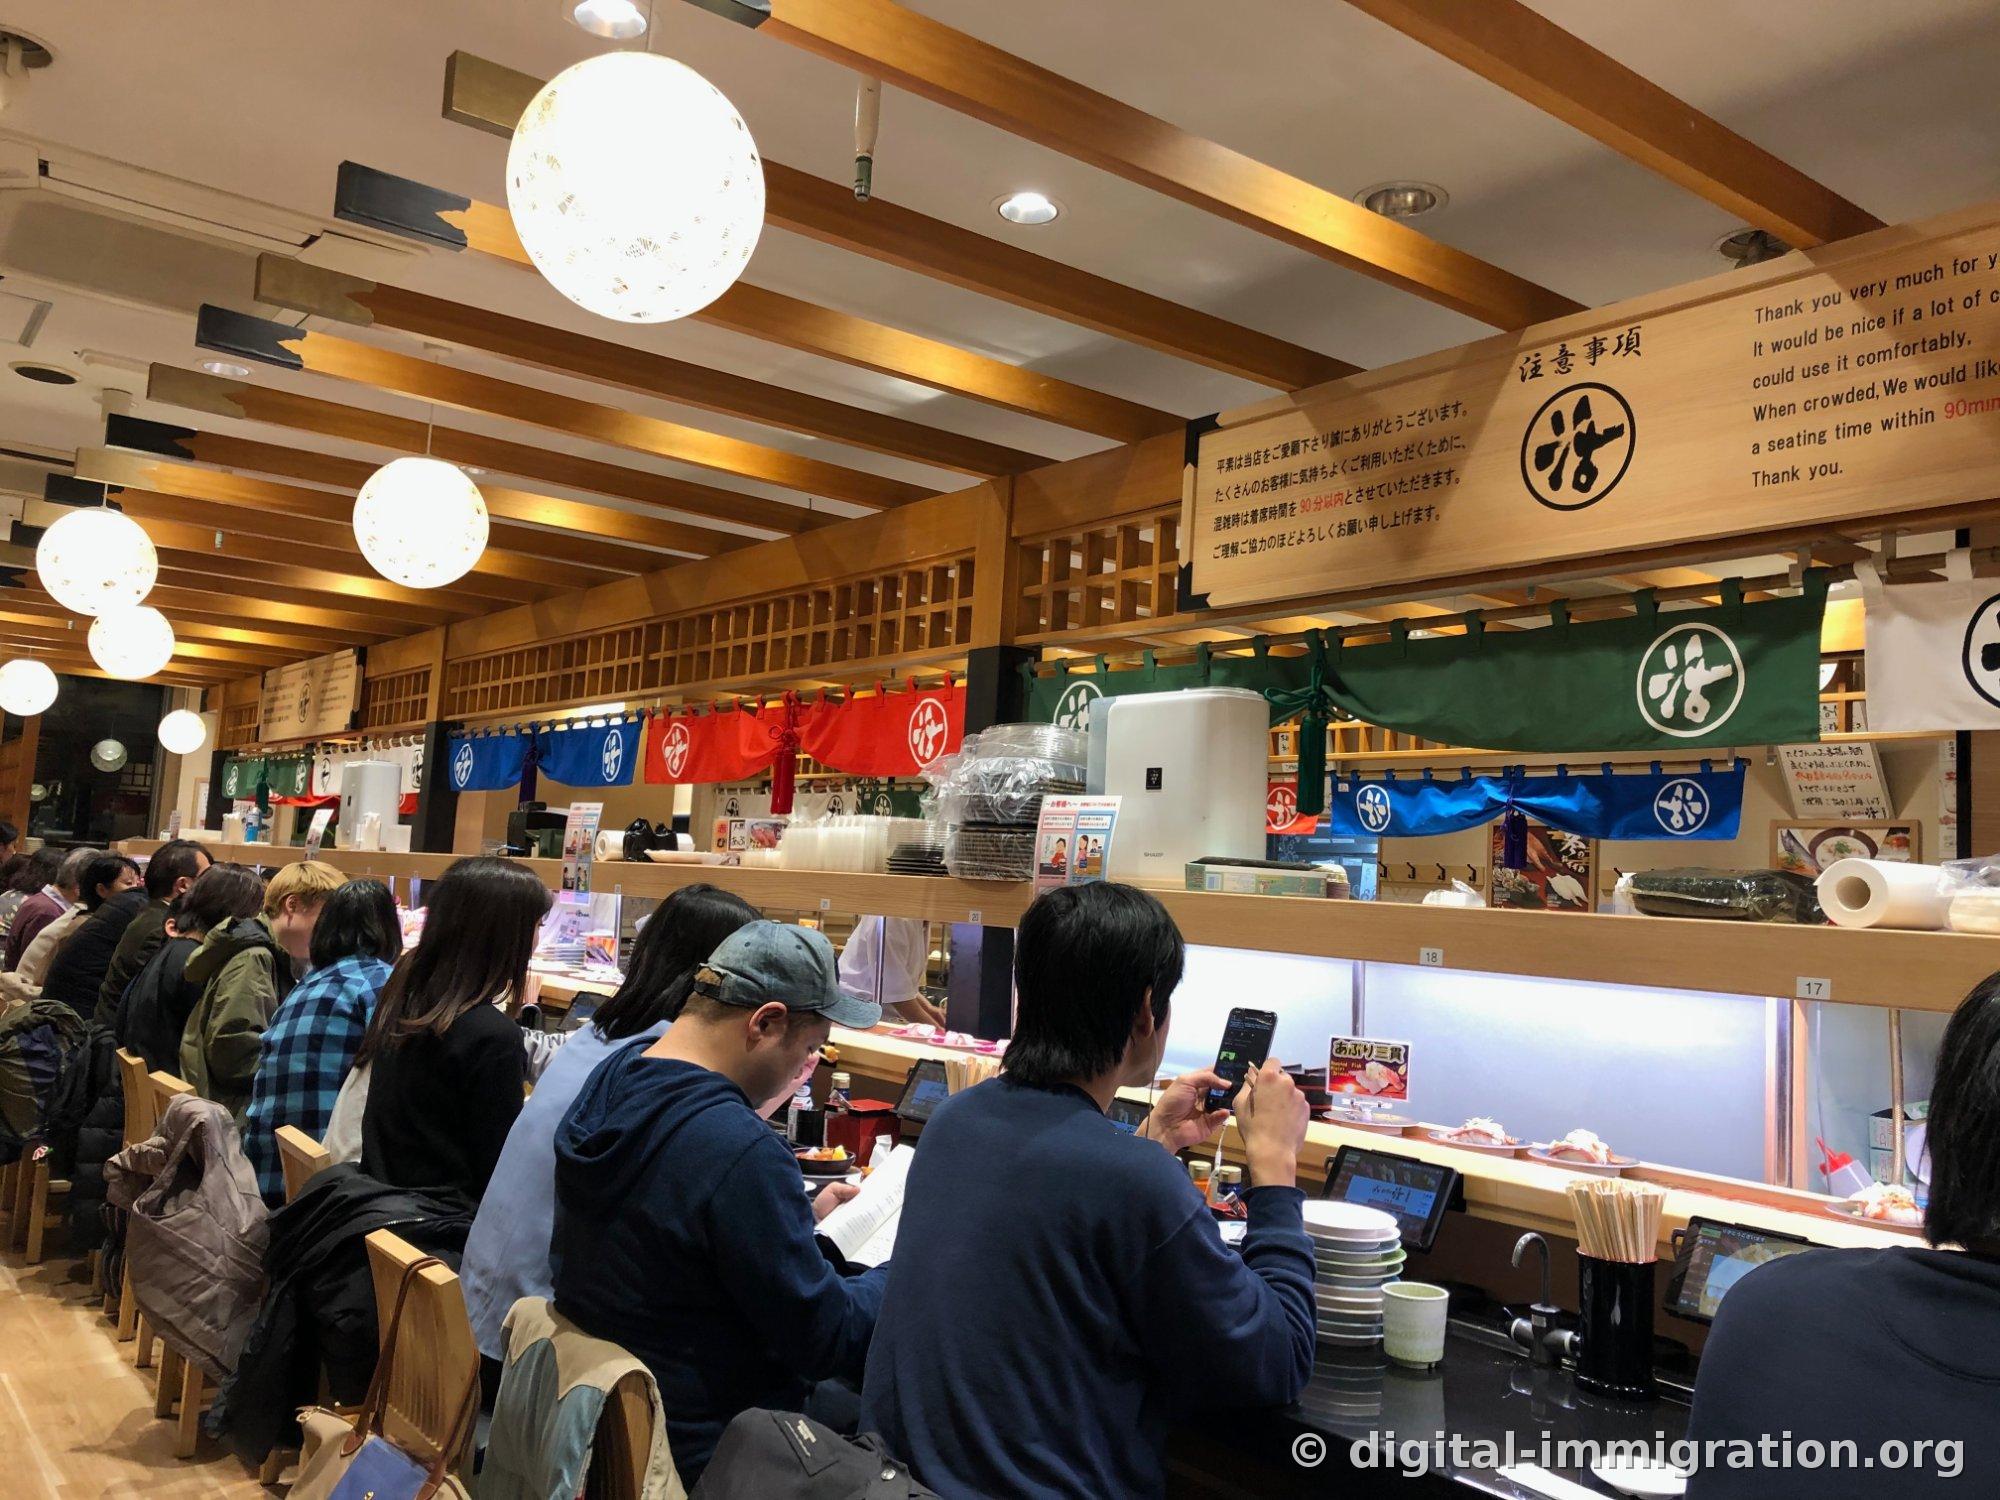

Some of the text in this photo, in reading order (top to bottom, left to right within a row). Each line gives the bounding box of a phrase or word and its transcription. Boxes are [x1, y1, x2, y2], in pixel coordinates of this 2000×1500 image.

[1755, 300, 1803, 324] Thank
[1812, 292, 1841, 312] you
[1850, 280, 1887, 301] very
[1896, 265, 1943, 290] much
[1953, 257, 1978, 276] for
[1754, 342, 1763, 357] It
[1771, 330, 1817, 353] would
[1825, 325, 1844, 341] be
[1852, 316, 1885, 335] nice
[1893, 309, 1904, 325] if
[1913, 310, 1923, 321] a
[1932, 299, 1954, 316] lot
[1963, 291, 1980, 309] of
[1518, 326, 1643, 383] 注意事項
[1753, 368, 1794, 389] could
[1802, 362, 1830, 379] use
[1838, 356, 1848, 371] it
[1753, 402, 1796, 422] When
[1914, 366, 1966, 390] would
[1752, 442, 1760, 455] a
[1768, 429, 1827, 452] seating
[1835, 420, 1871, 440] time
[1881, 408, 1935, 432] within
[1752, 461, 1843, 487] Thank you.
[1425, 951, 1438, 963] 18
[1805, 982, 1823, 995] 17
[1334, 1041, 1403, 1062] あぶり三貫
